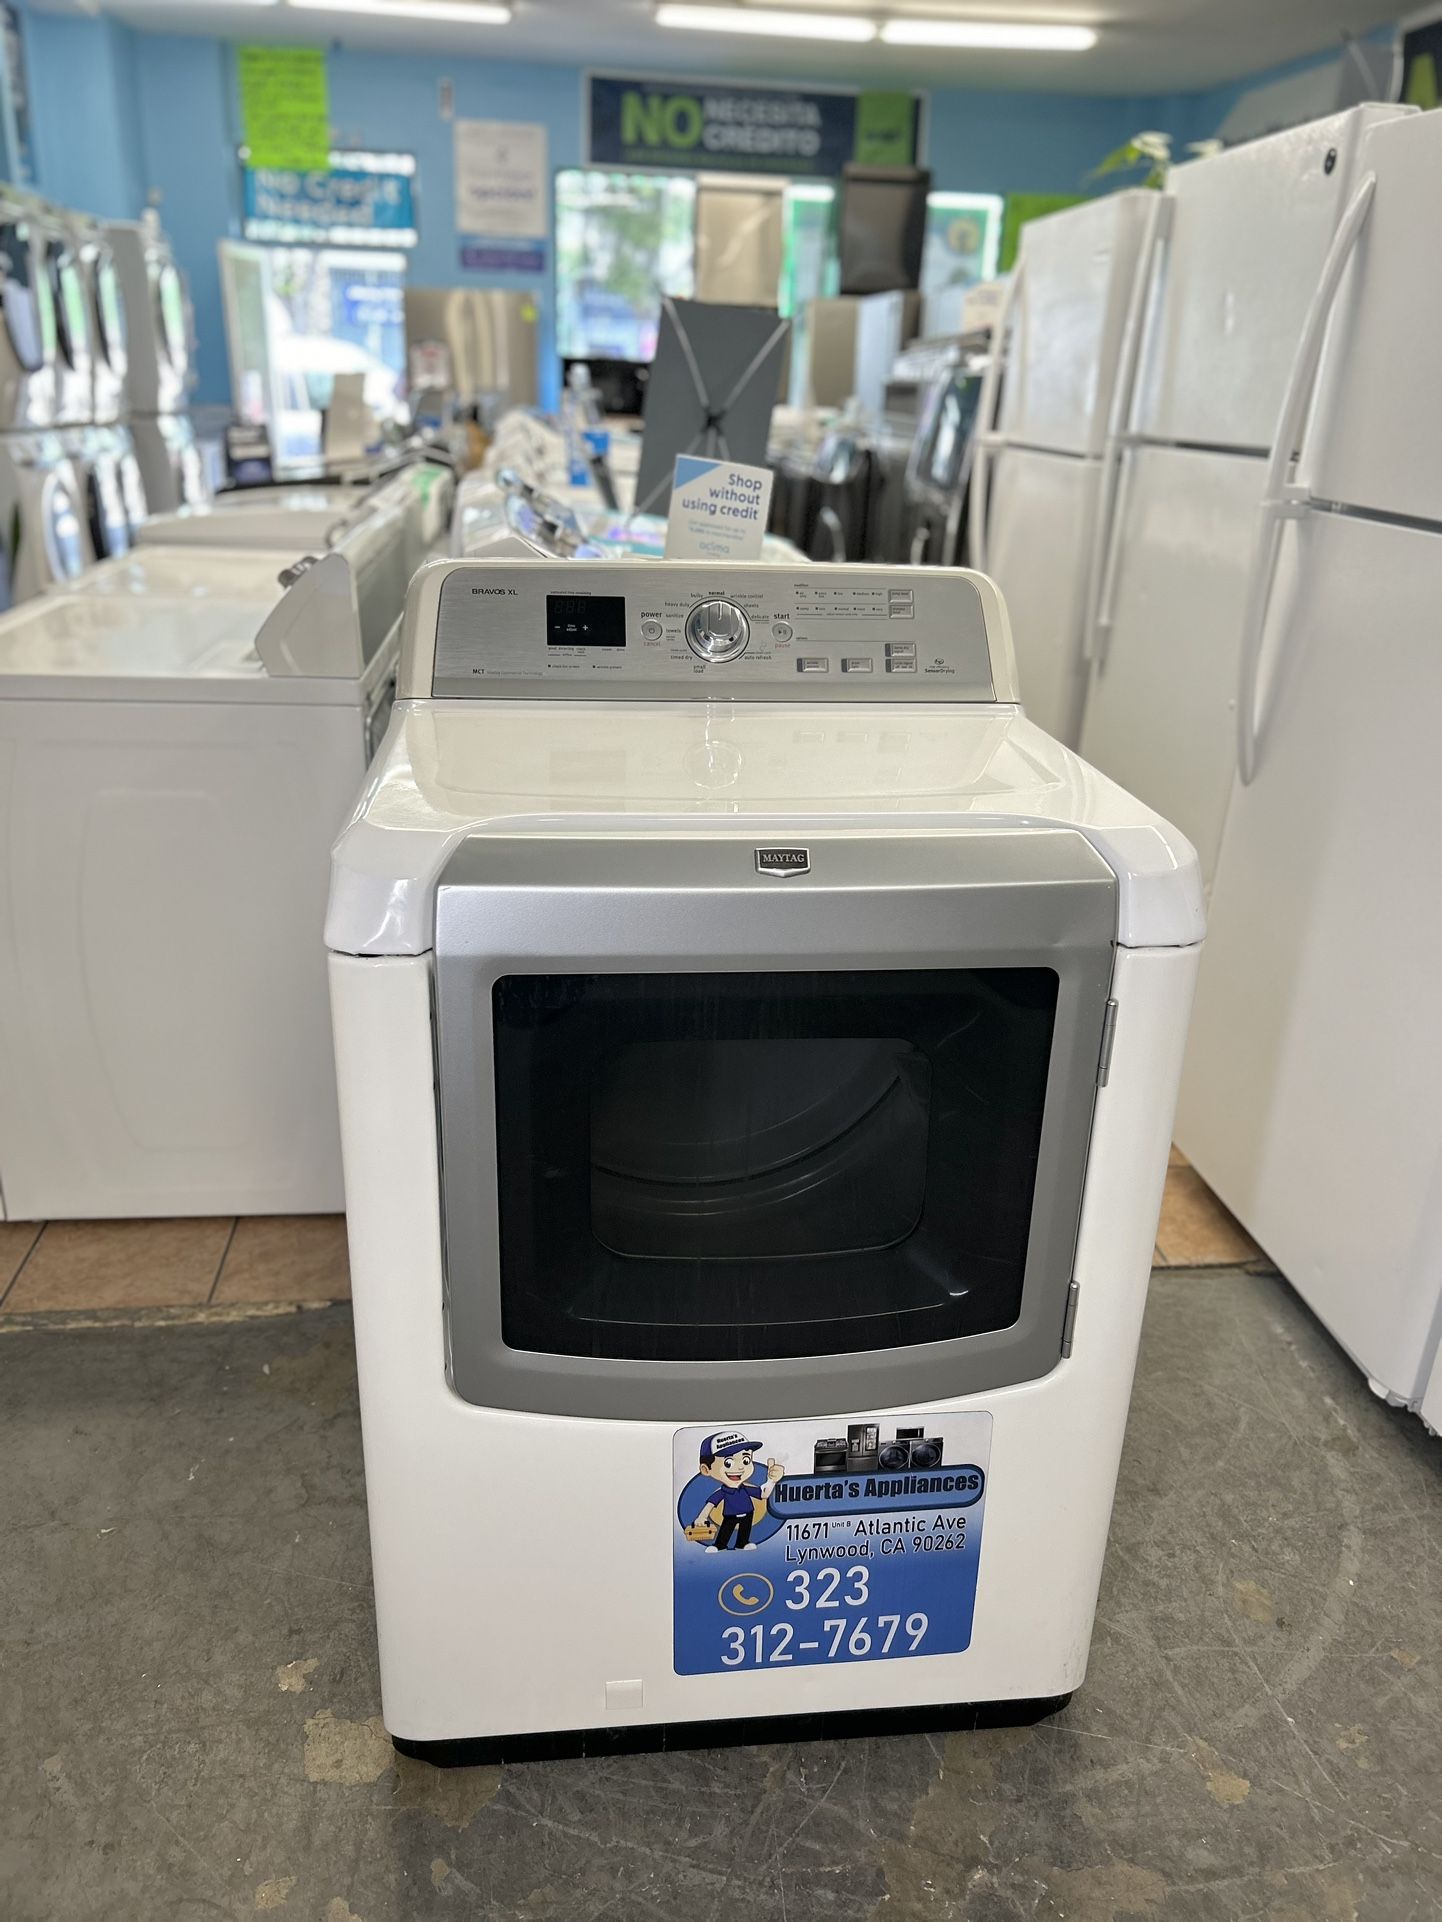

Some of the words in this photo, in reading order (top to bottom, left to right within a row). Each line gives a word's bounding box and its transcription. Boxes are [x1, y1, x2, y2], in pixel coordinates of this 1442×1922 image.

[621, 91, 702, 148] NO
[709, 487, 760, 505] without
[728, 473, 762, 492] Shop
[682, 498, 717, 515] using
[720, 505, 758, 520] credit
[762, 853, 805, 863] MAYTAG
[774, 1478, 860, 1503] Huerta's
[864, 1473, 980, 1499] Appliances
[786, 1522, 829, 1542] 11671
[831, 1521, 845, 1529] Unit
[853, 1516, 927, 1537] Atlantic
[931, 1514, 967, 1530] Ave
[785, 1540, 875, 1565] Lynwood,
[880, 1538, 906, 1555] CA
[912, 1533, 966, 1553] 90262
[785, 1565, 870, 1611] 323
[720, 1612, 929, 1666] 312-7679
